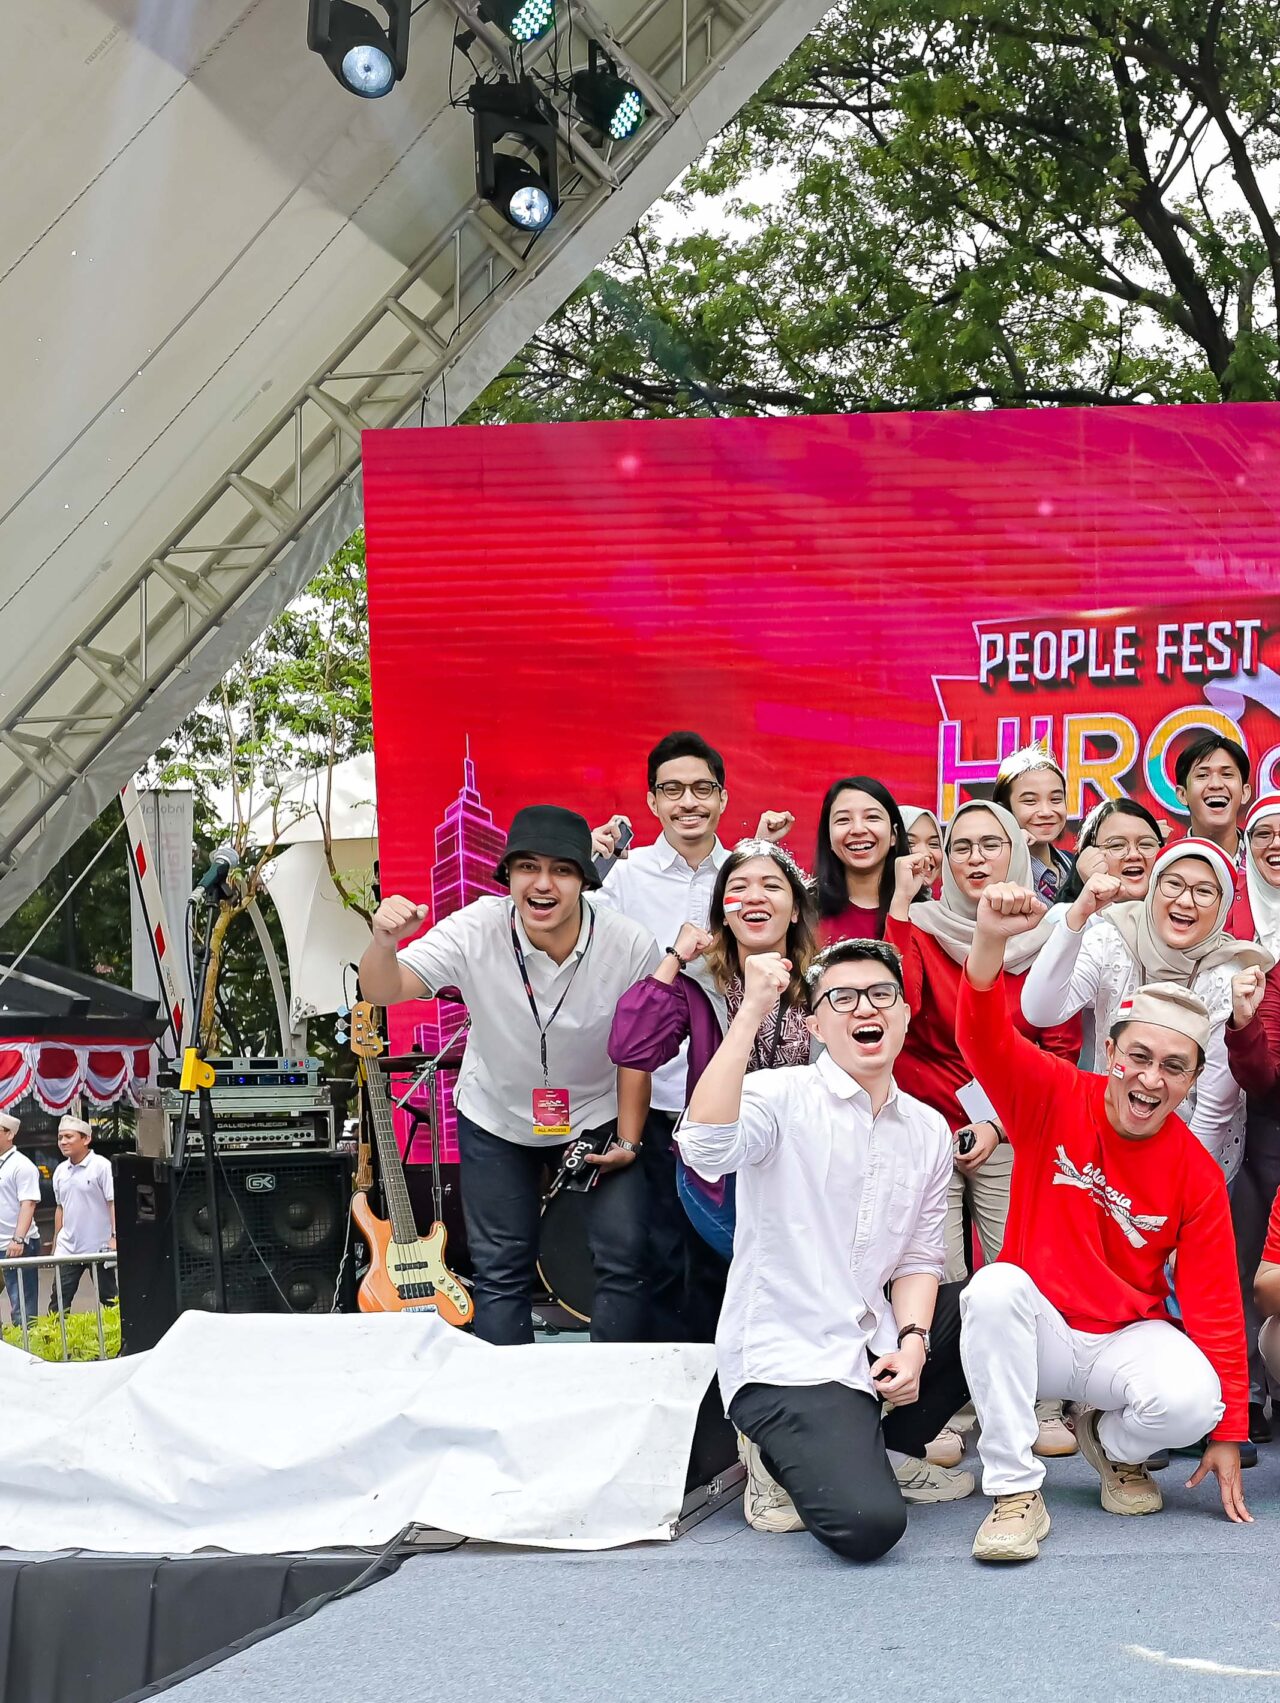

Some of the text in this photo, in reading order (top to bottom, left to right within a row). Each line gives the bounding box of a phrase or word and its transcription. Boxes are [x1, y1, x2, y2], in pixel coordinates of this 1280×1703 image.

[979, 619, 1261, 683] PEOPLE FEST
[216, 1121, 288, 1129] GALLIEN-KRUEGER
